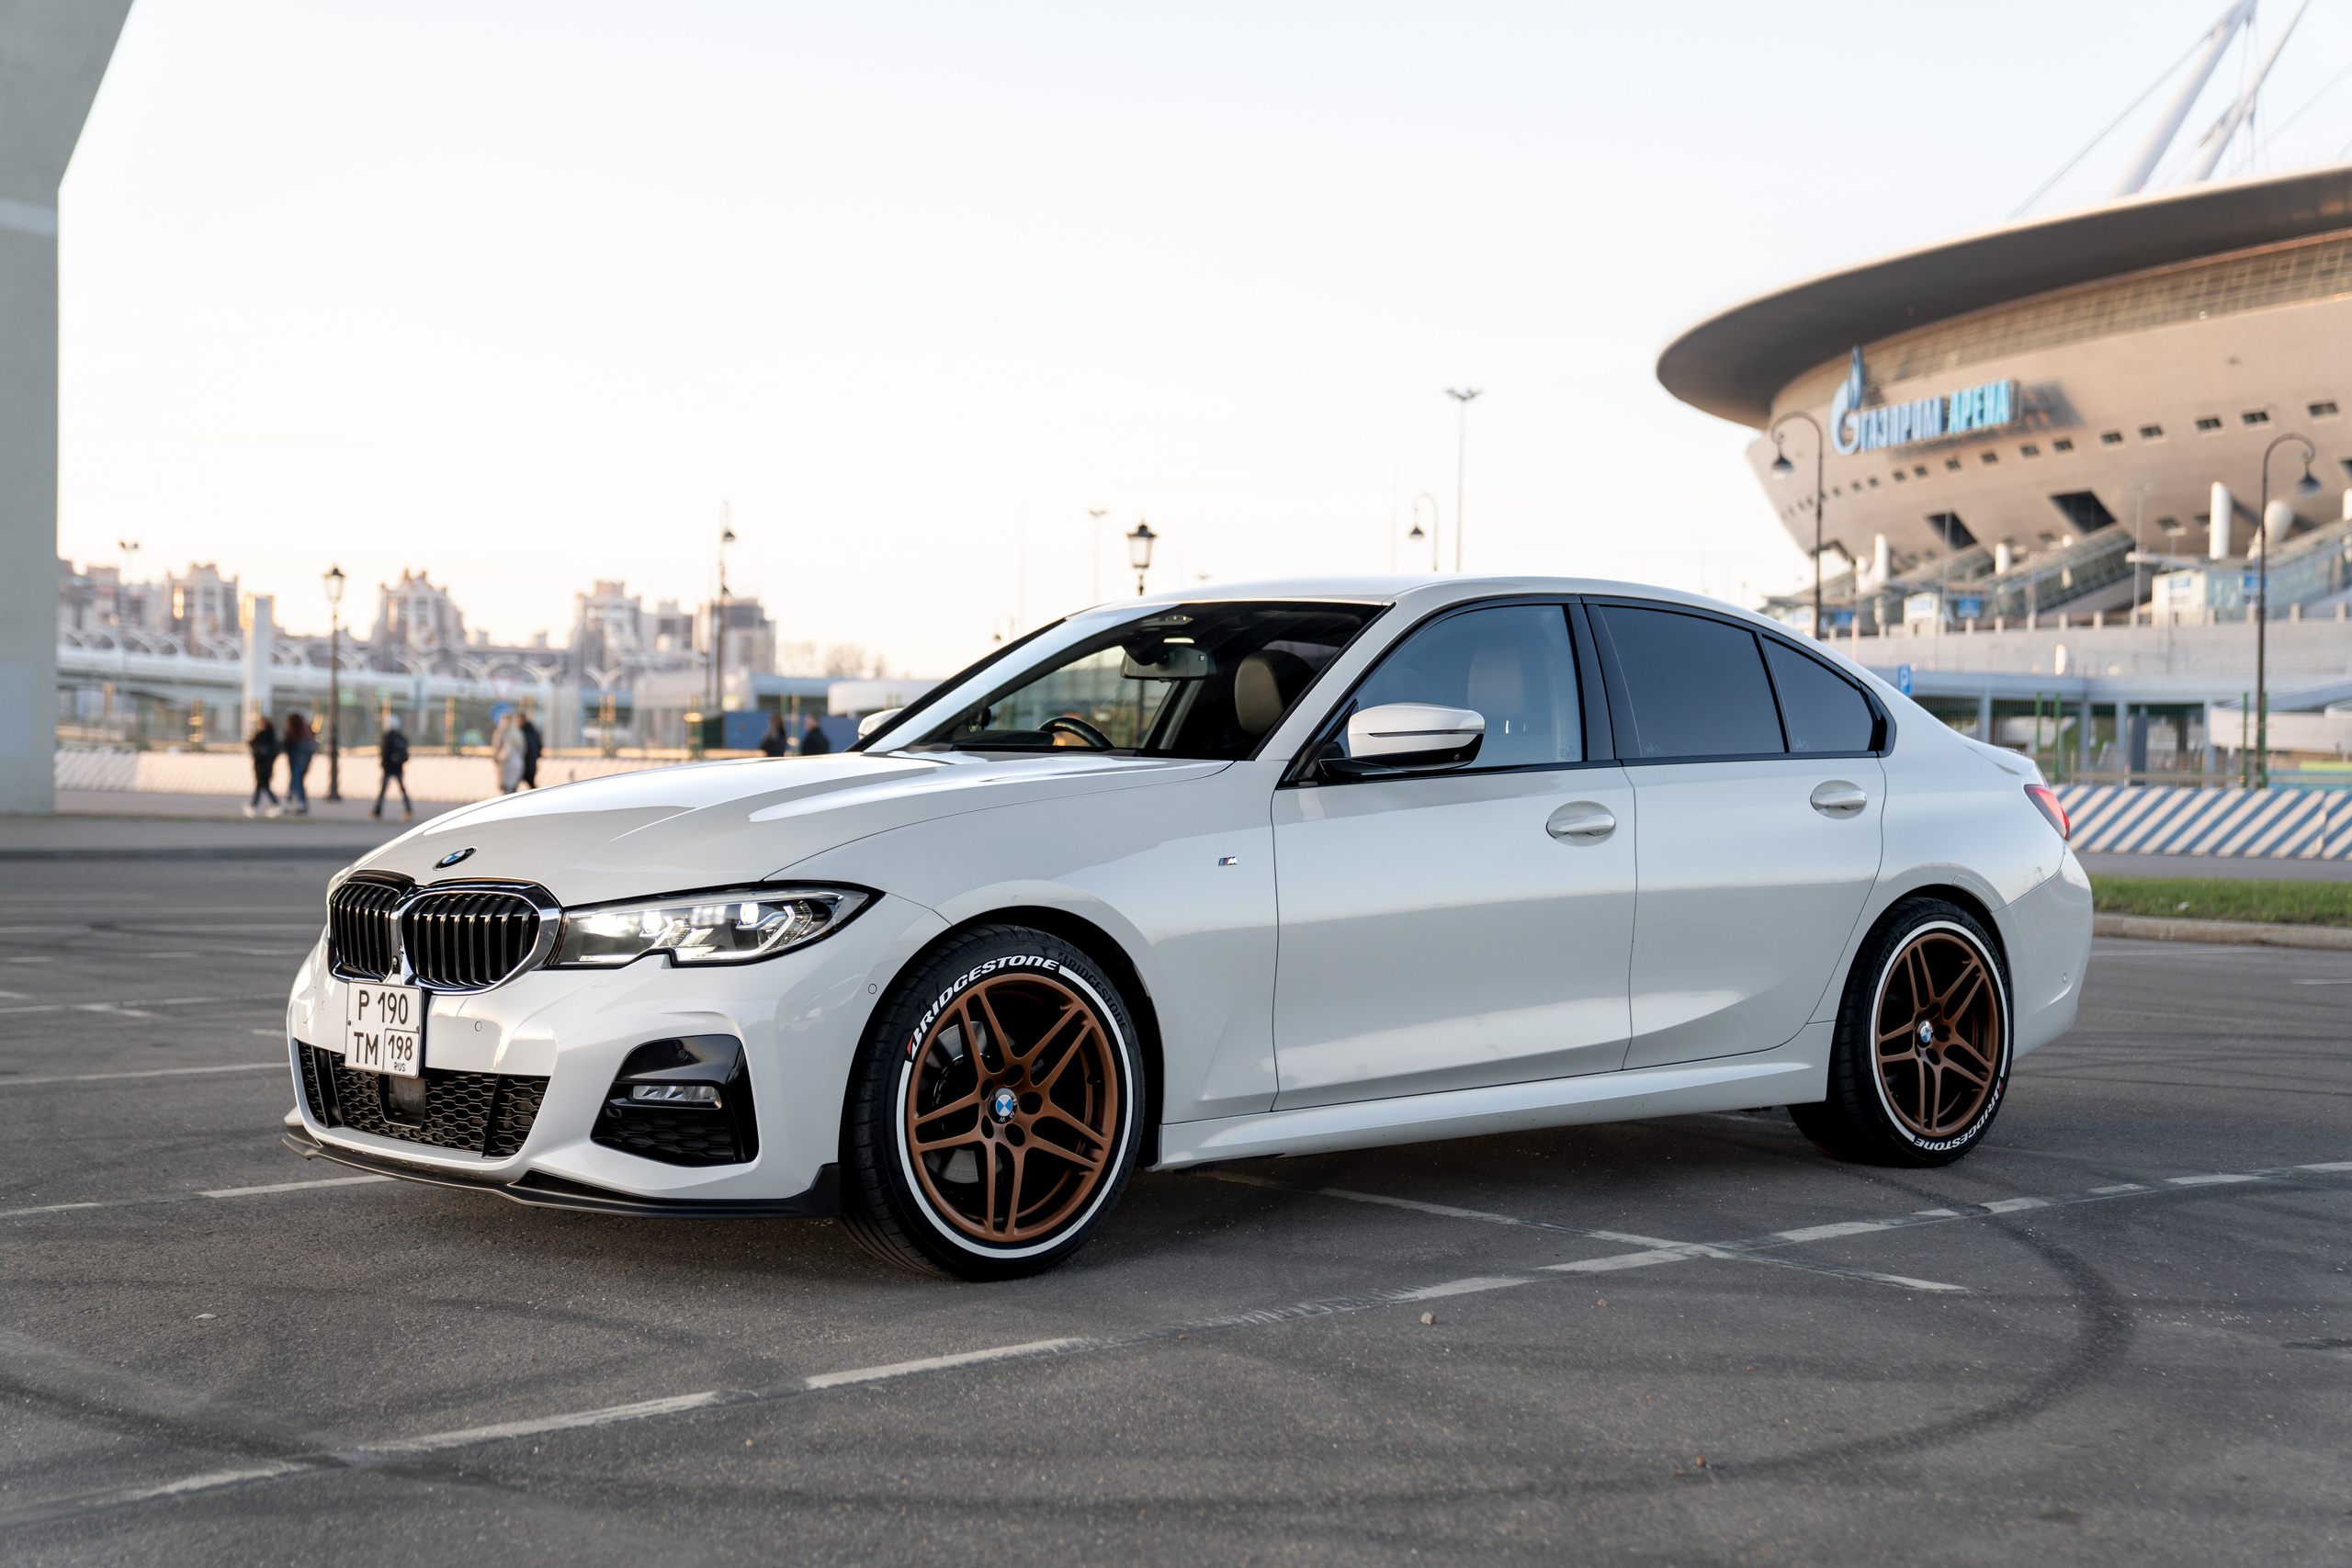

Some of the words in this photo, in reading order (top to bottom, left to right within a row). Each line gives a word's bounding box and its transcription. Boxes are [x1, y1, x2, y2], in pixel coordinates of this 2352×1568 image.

[1948, 378, 2011, 435] АРЕНА
[378, 991, 408, 1024] 190
[907, 954, 1060, 1060] BRIDGESTONE
[388, 1034, 413, 1061] 198
[393, 1061, 406, 1072] RUS
[1914, 1077, 2003, 1151] BRIDGESTONE
